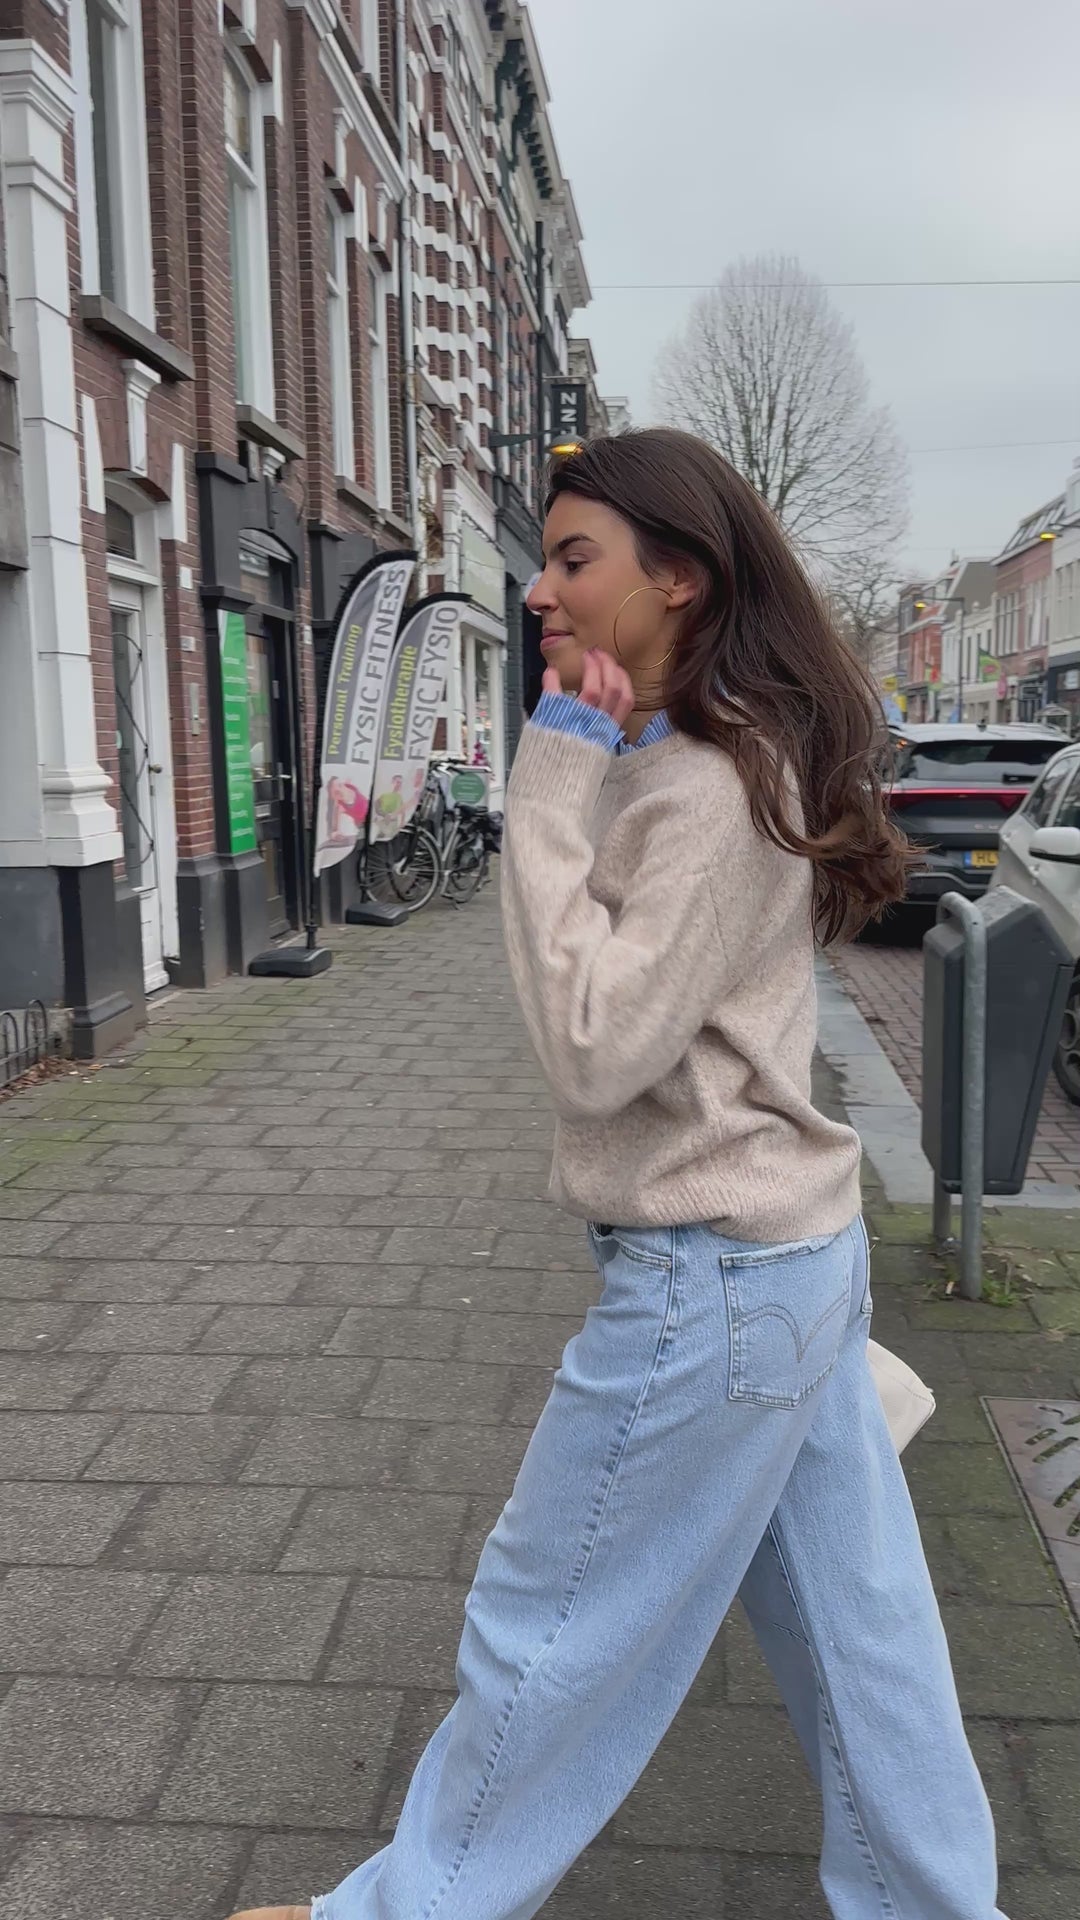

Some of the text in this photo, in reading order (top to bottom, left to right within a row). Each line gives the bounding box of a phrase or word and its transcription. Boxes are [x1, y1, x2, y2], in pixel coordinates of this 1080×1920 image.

[328, 624, 362, 754] Personal Training
[351, 569, 406, 764] FYSIC FITNESS
[384, 645, 417, 757] Fysiotherapie
[408, 607, 459, 760] FYSIC FYSIO
